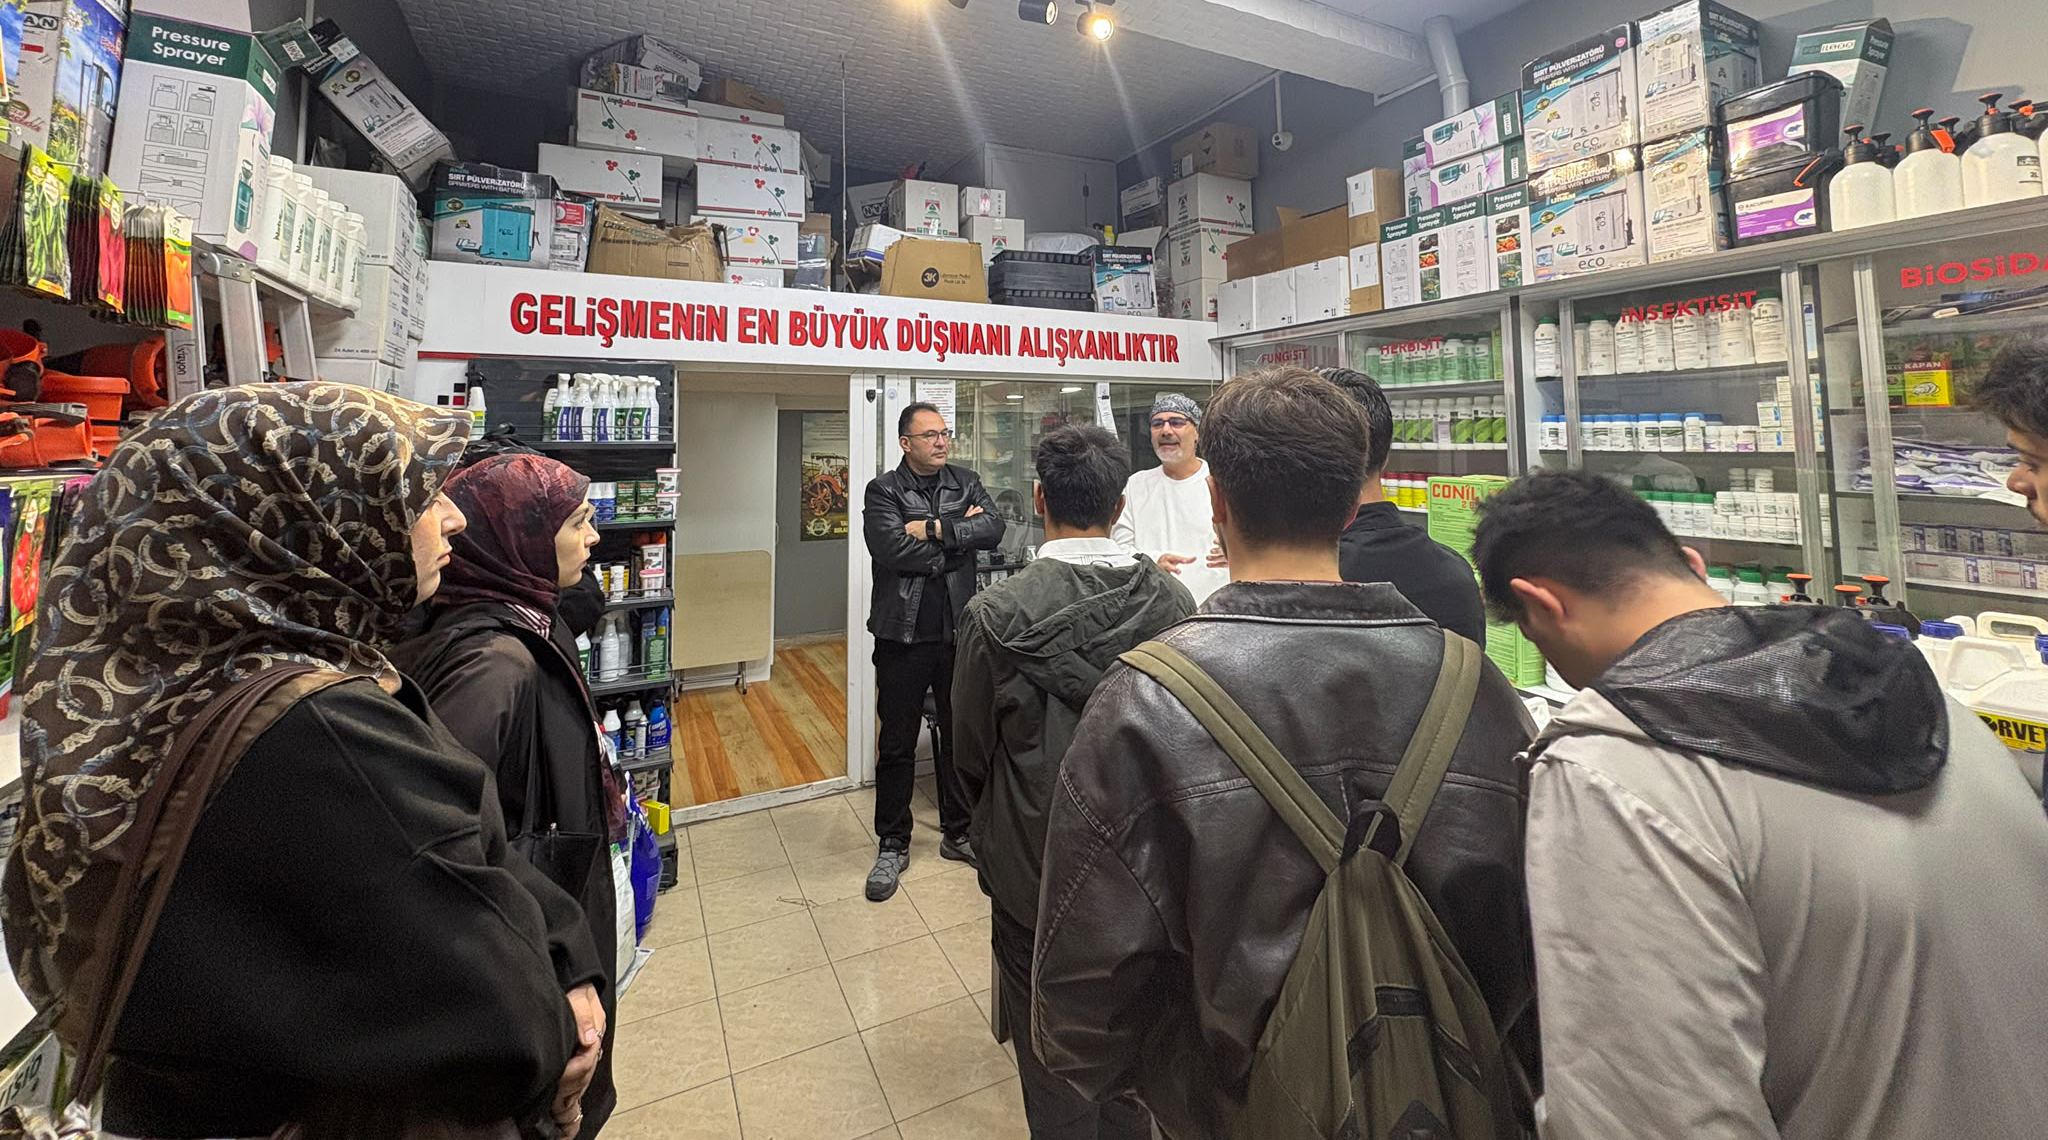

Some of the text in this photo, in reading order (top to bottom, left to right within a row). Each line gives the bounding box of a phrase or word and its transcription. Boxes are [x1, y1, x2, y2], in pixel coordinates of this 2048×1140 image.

[152, 26, 231, 52] Pressure
[152, 42, 227, 66] Sprayer
[1562, 64, 1579, 75] WITH
[1579, 53, 1605, 68] BATTERY
[1573, 137, 1600, 152] eco
[448, 173, 466, 182] SIRT
[1568, 180, 1584, 190] WITH
[1584, 172, 1611, 185] BATTERY
[448, 180, 481, 190] SPRAYERS
[481, 184, 498, 192] WITH
[1493, 190, 1522, 203] Pressure
[1452, 201, 1477, 213] Pressure
[1495, 199, 1521, 211] Sprayer
[1417, 212, 1441, 223] Pressure
[1453, 208, 1476, 220] Sprayer
[1385, 222, 1408, 232] Pressure
[1418, 218, 1440, 229] Sprayer
[1386, 229, 1408, 240] Sprayer
[1578, 257, 1605, 270] eco
[923, 271, 938, 283] 3K
[738, 307, 779, 345] EN
[789, 304, 889, 351] BÜYÜK
[897, 312, 1011, 362] DÜŞMANI
[1018, 326, 1180, 367] ALIŞKANLIKTIR
[1904, 361, 1942, 370] KAPAN
